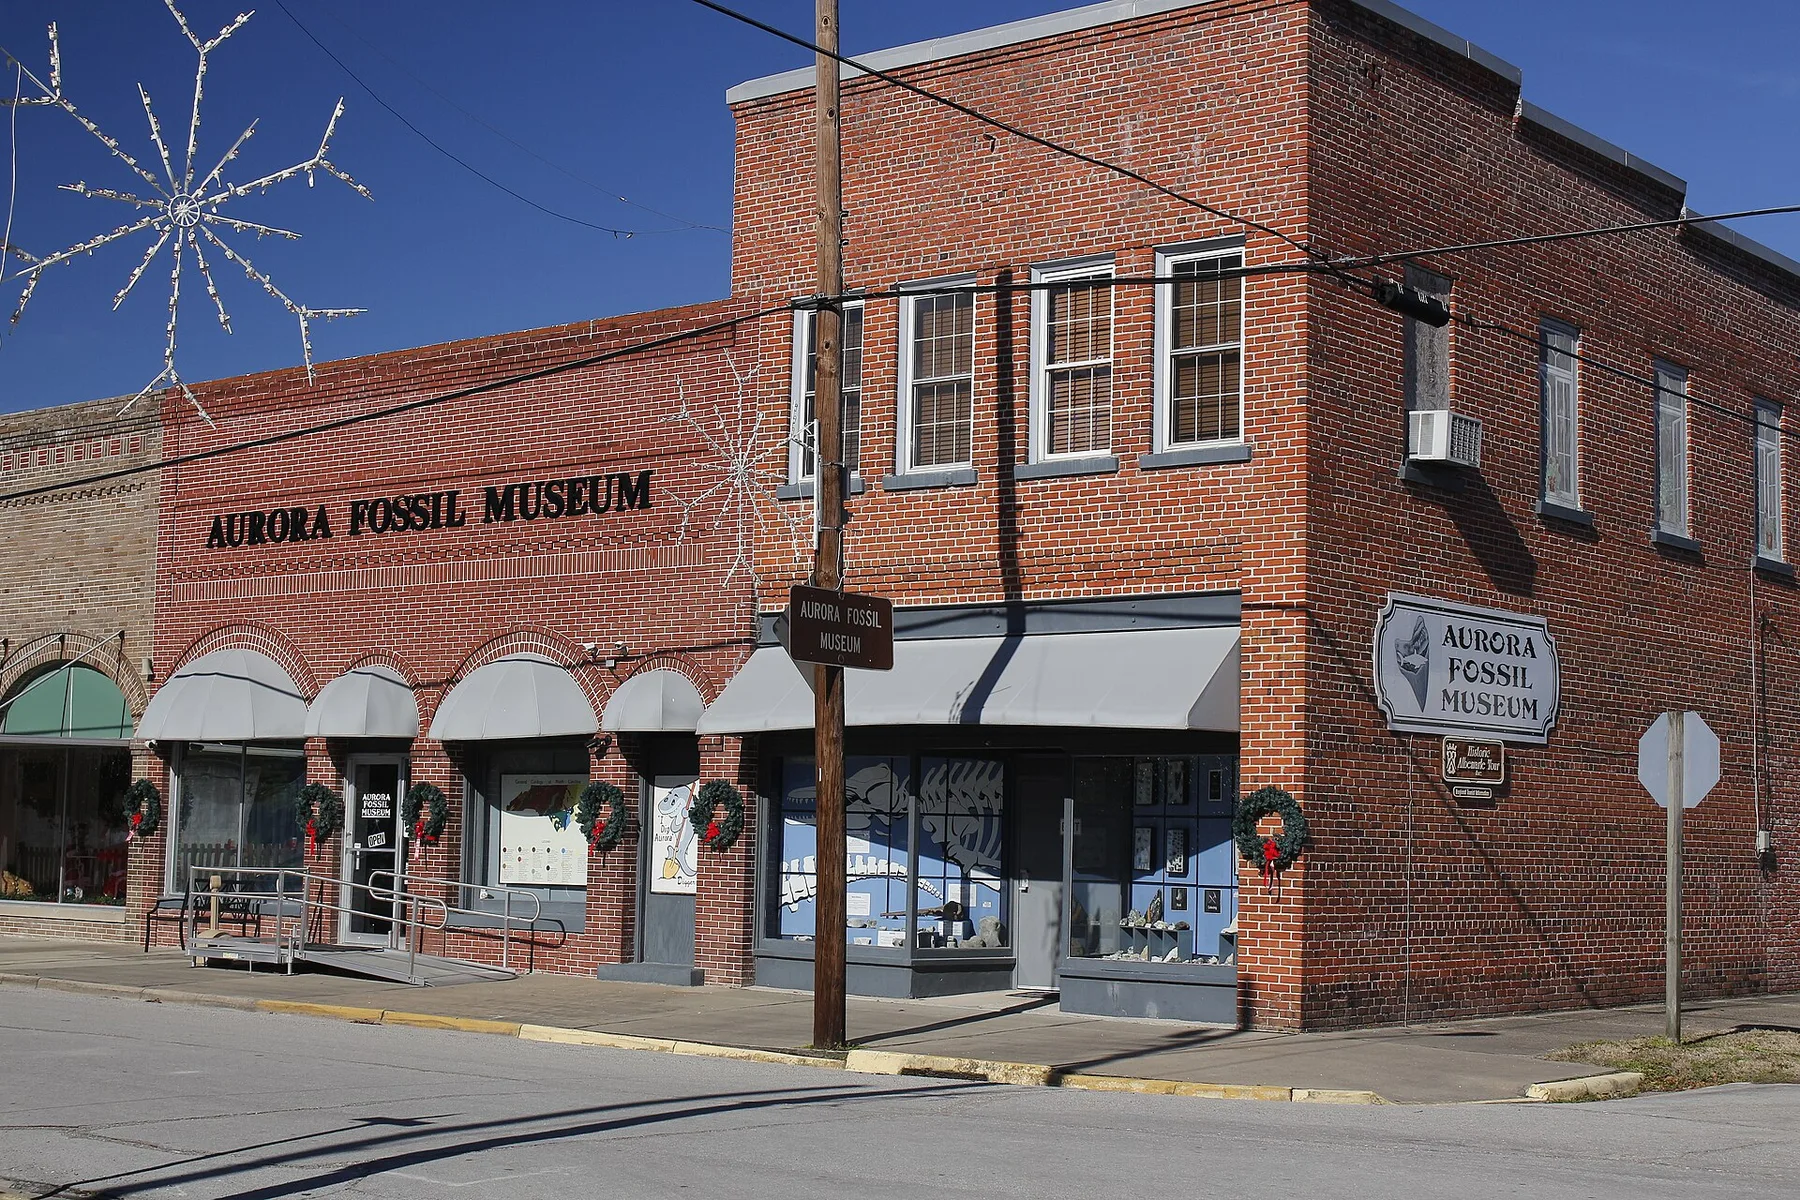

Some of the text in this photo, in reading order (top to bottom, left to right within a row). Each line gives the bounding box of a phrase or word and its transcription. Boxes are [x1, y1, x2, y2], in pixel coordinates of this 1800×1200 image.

[207, 470, 654, 549] AURORA FOSSIL MUSEUM
[800, 600, 882, 628] AURORA FOSSIL
[820, 631, 861, 654] MUSEUM
[1442, 624, 1537, 659] AURORA
[1448, 657, 1533, 690] FOSSIL
[1441, 688, 1538, 721] MUSEUM
[369, 834, 385, 845] OPEN
